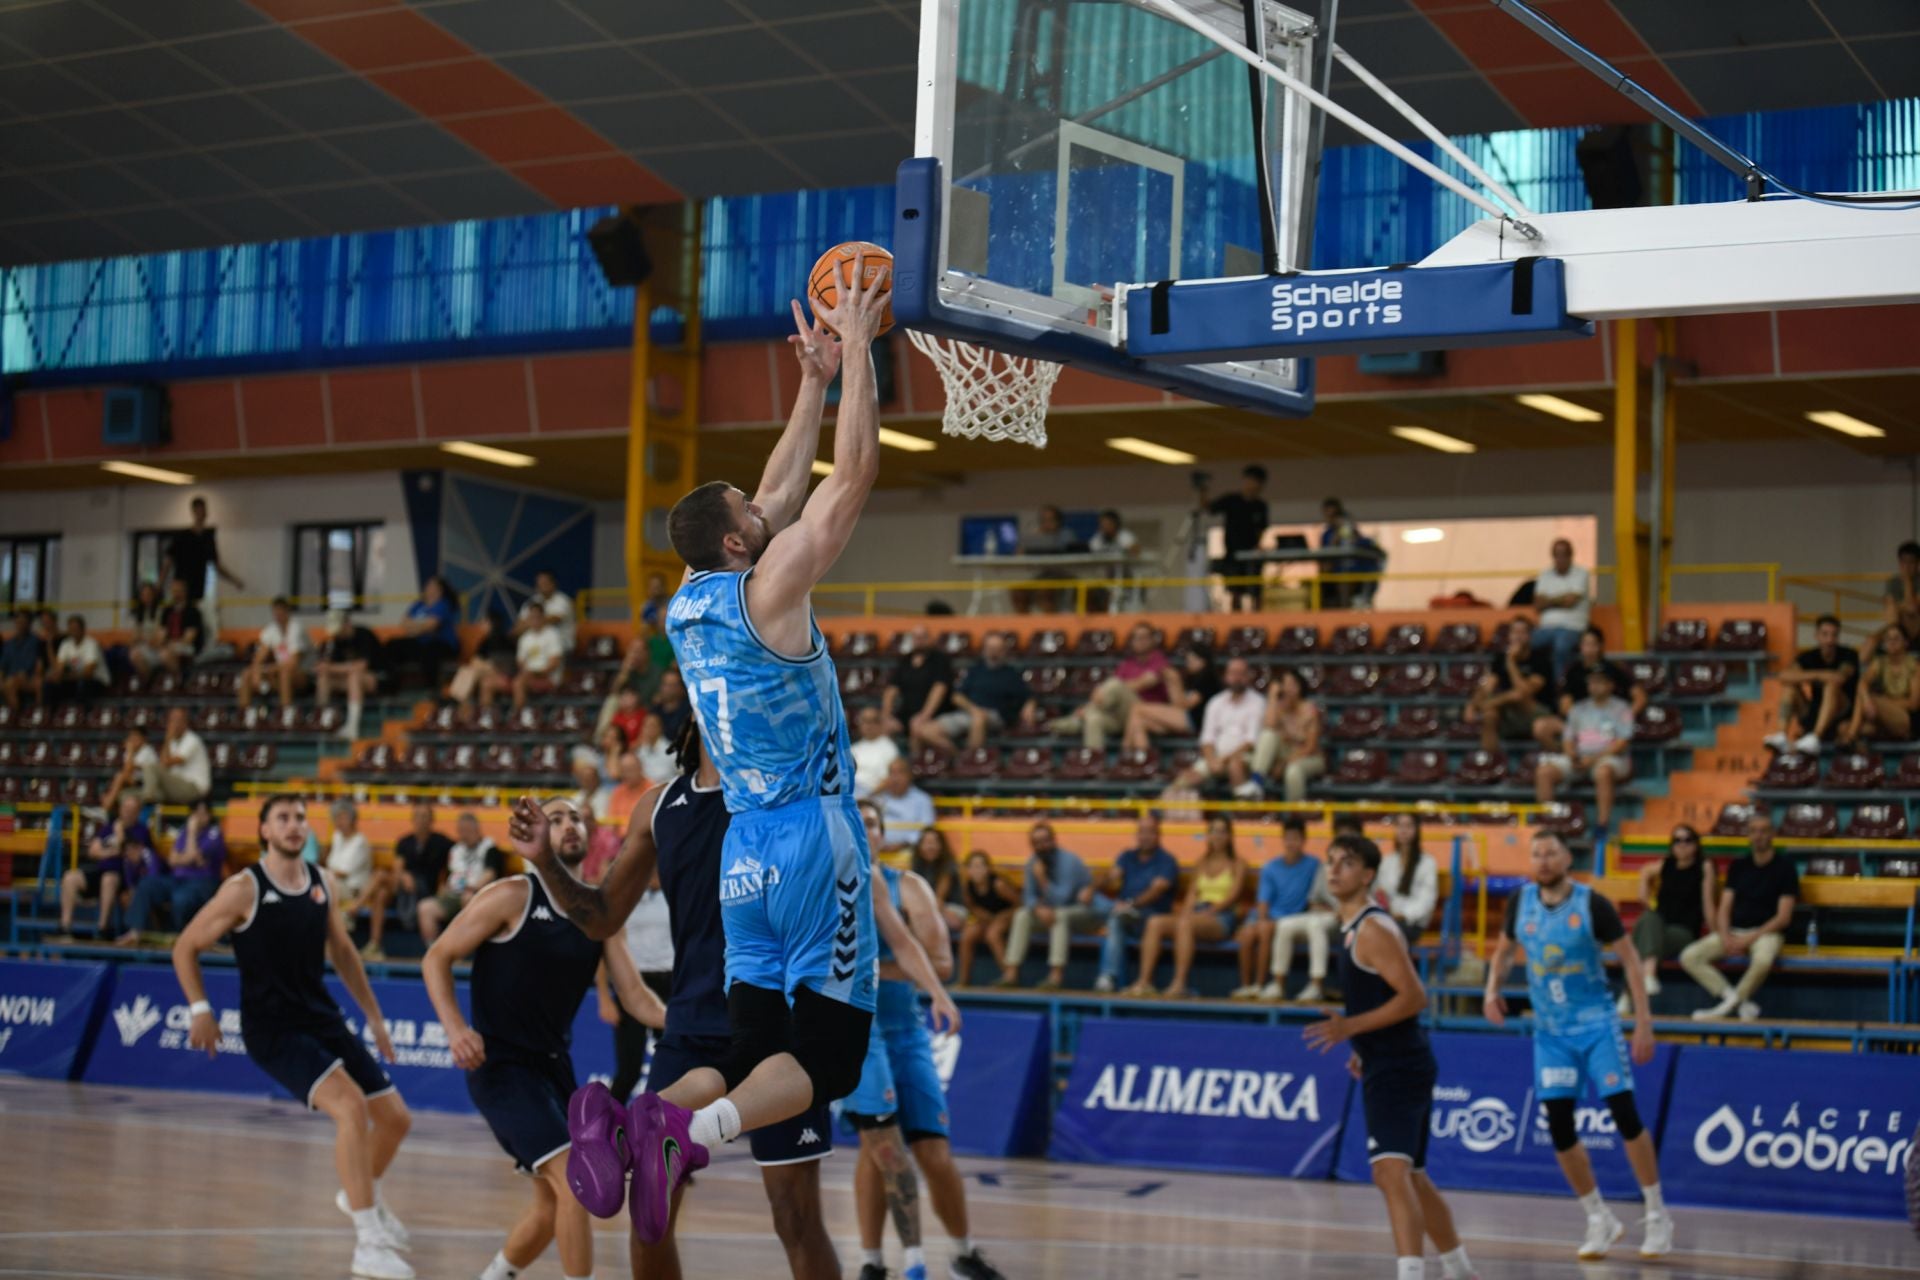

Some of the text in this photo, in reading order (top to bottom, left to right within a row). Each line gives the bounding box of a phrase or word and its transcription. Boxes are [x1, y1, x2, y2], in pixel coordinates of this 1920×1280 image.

[1271, 278, 1402, 307] Schelde
[1271, 302, 1402, 336] Sports
[688, 676, 734, 757] 17
[1083, 1063, 1321, 1122] ALIMERKA
[1744, 1126, 1915, 1175] cobrer
